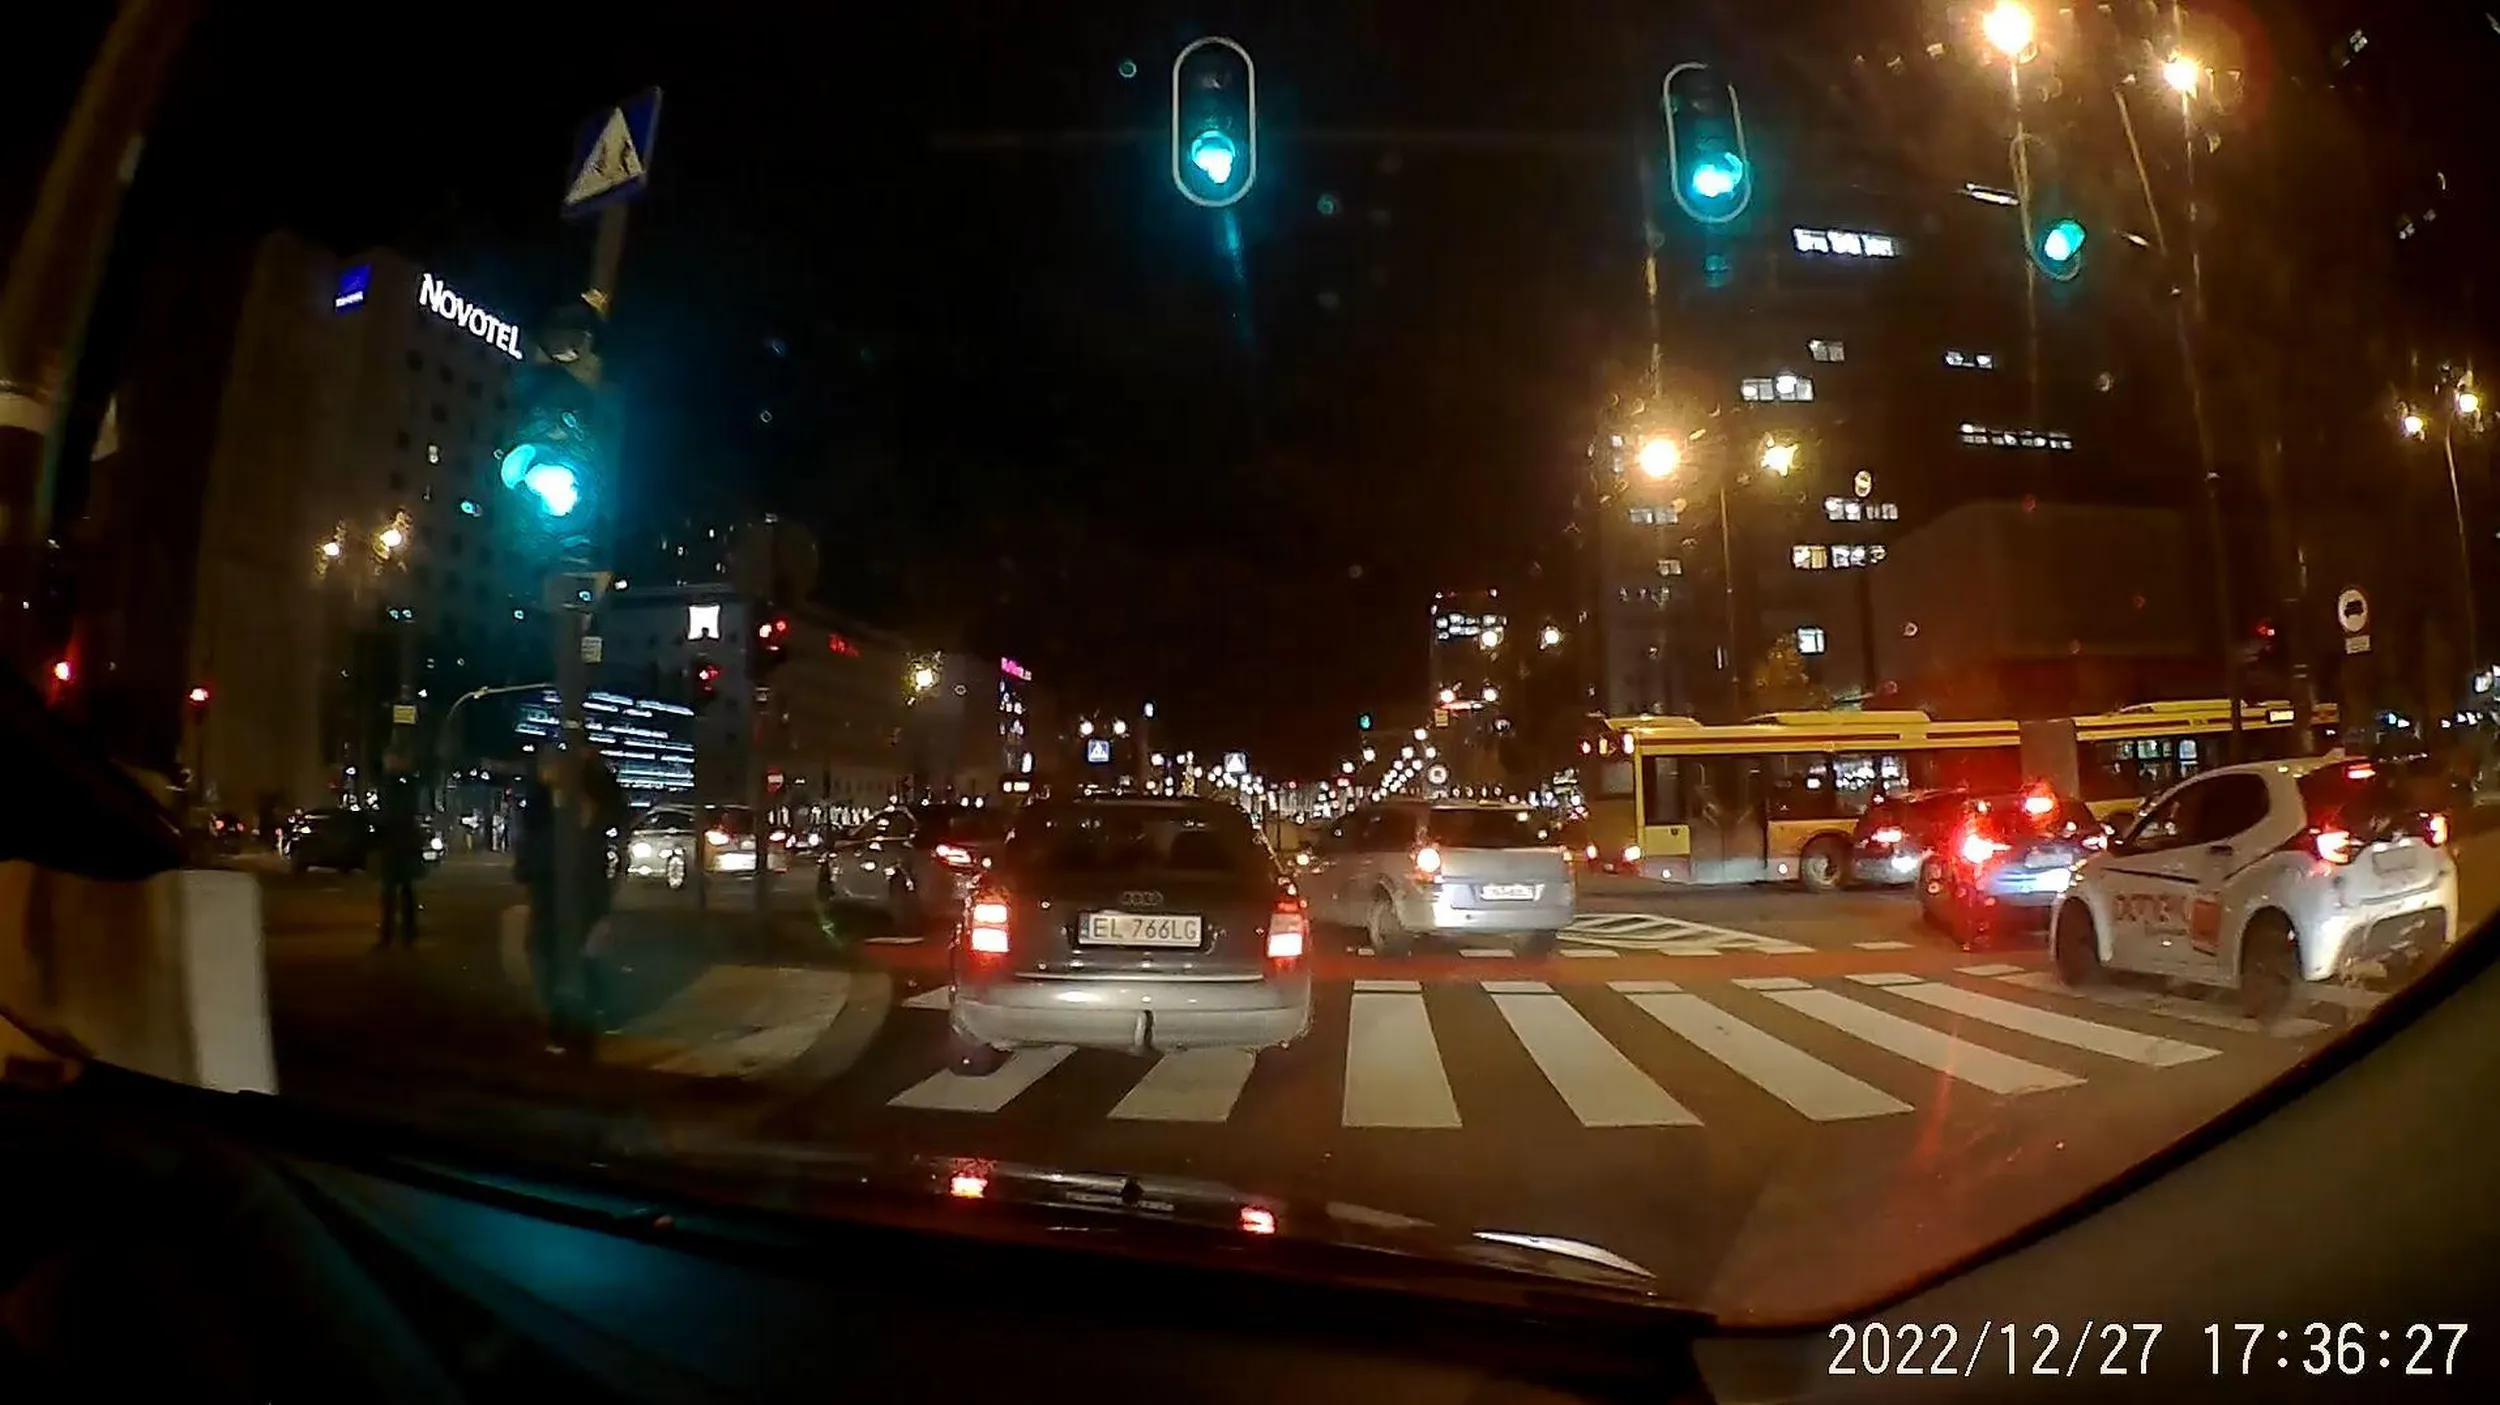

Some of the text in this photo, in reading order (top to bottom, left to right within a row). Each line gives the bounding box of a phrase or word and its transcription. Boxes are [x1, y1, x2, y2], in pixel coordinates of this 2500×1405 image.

[420, 274, 522, 359] NOVOTEL
[1093, 917, 1197, 940] EL 766LG
